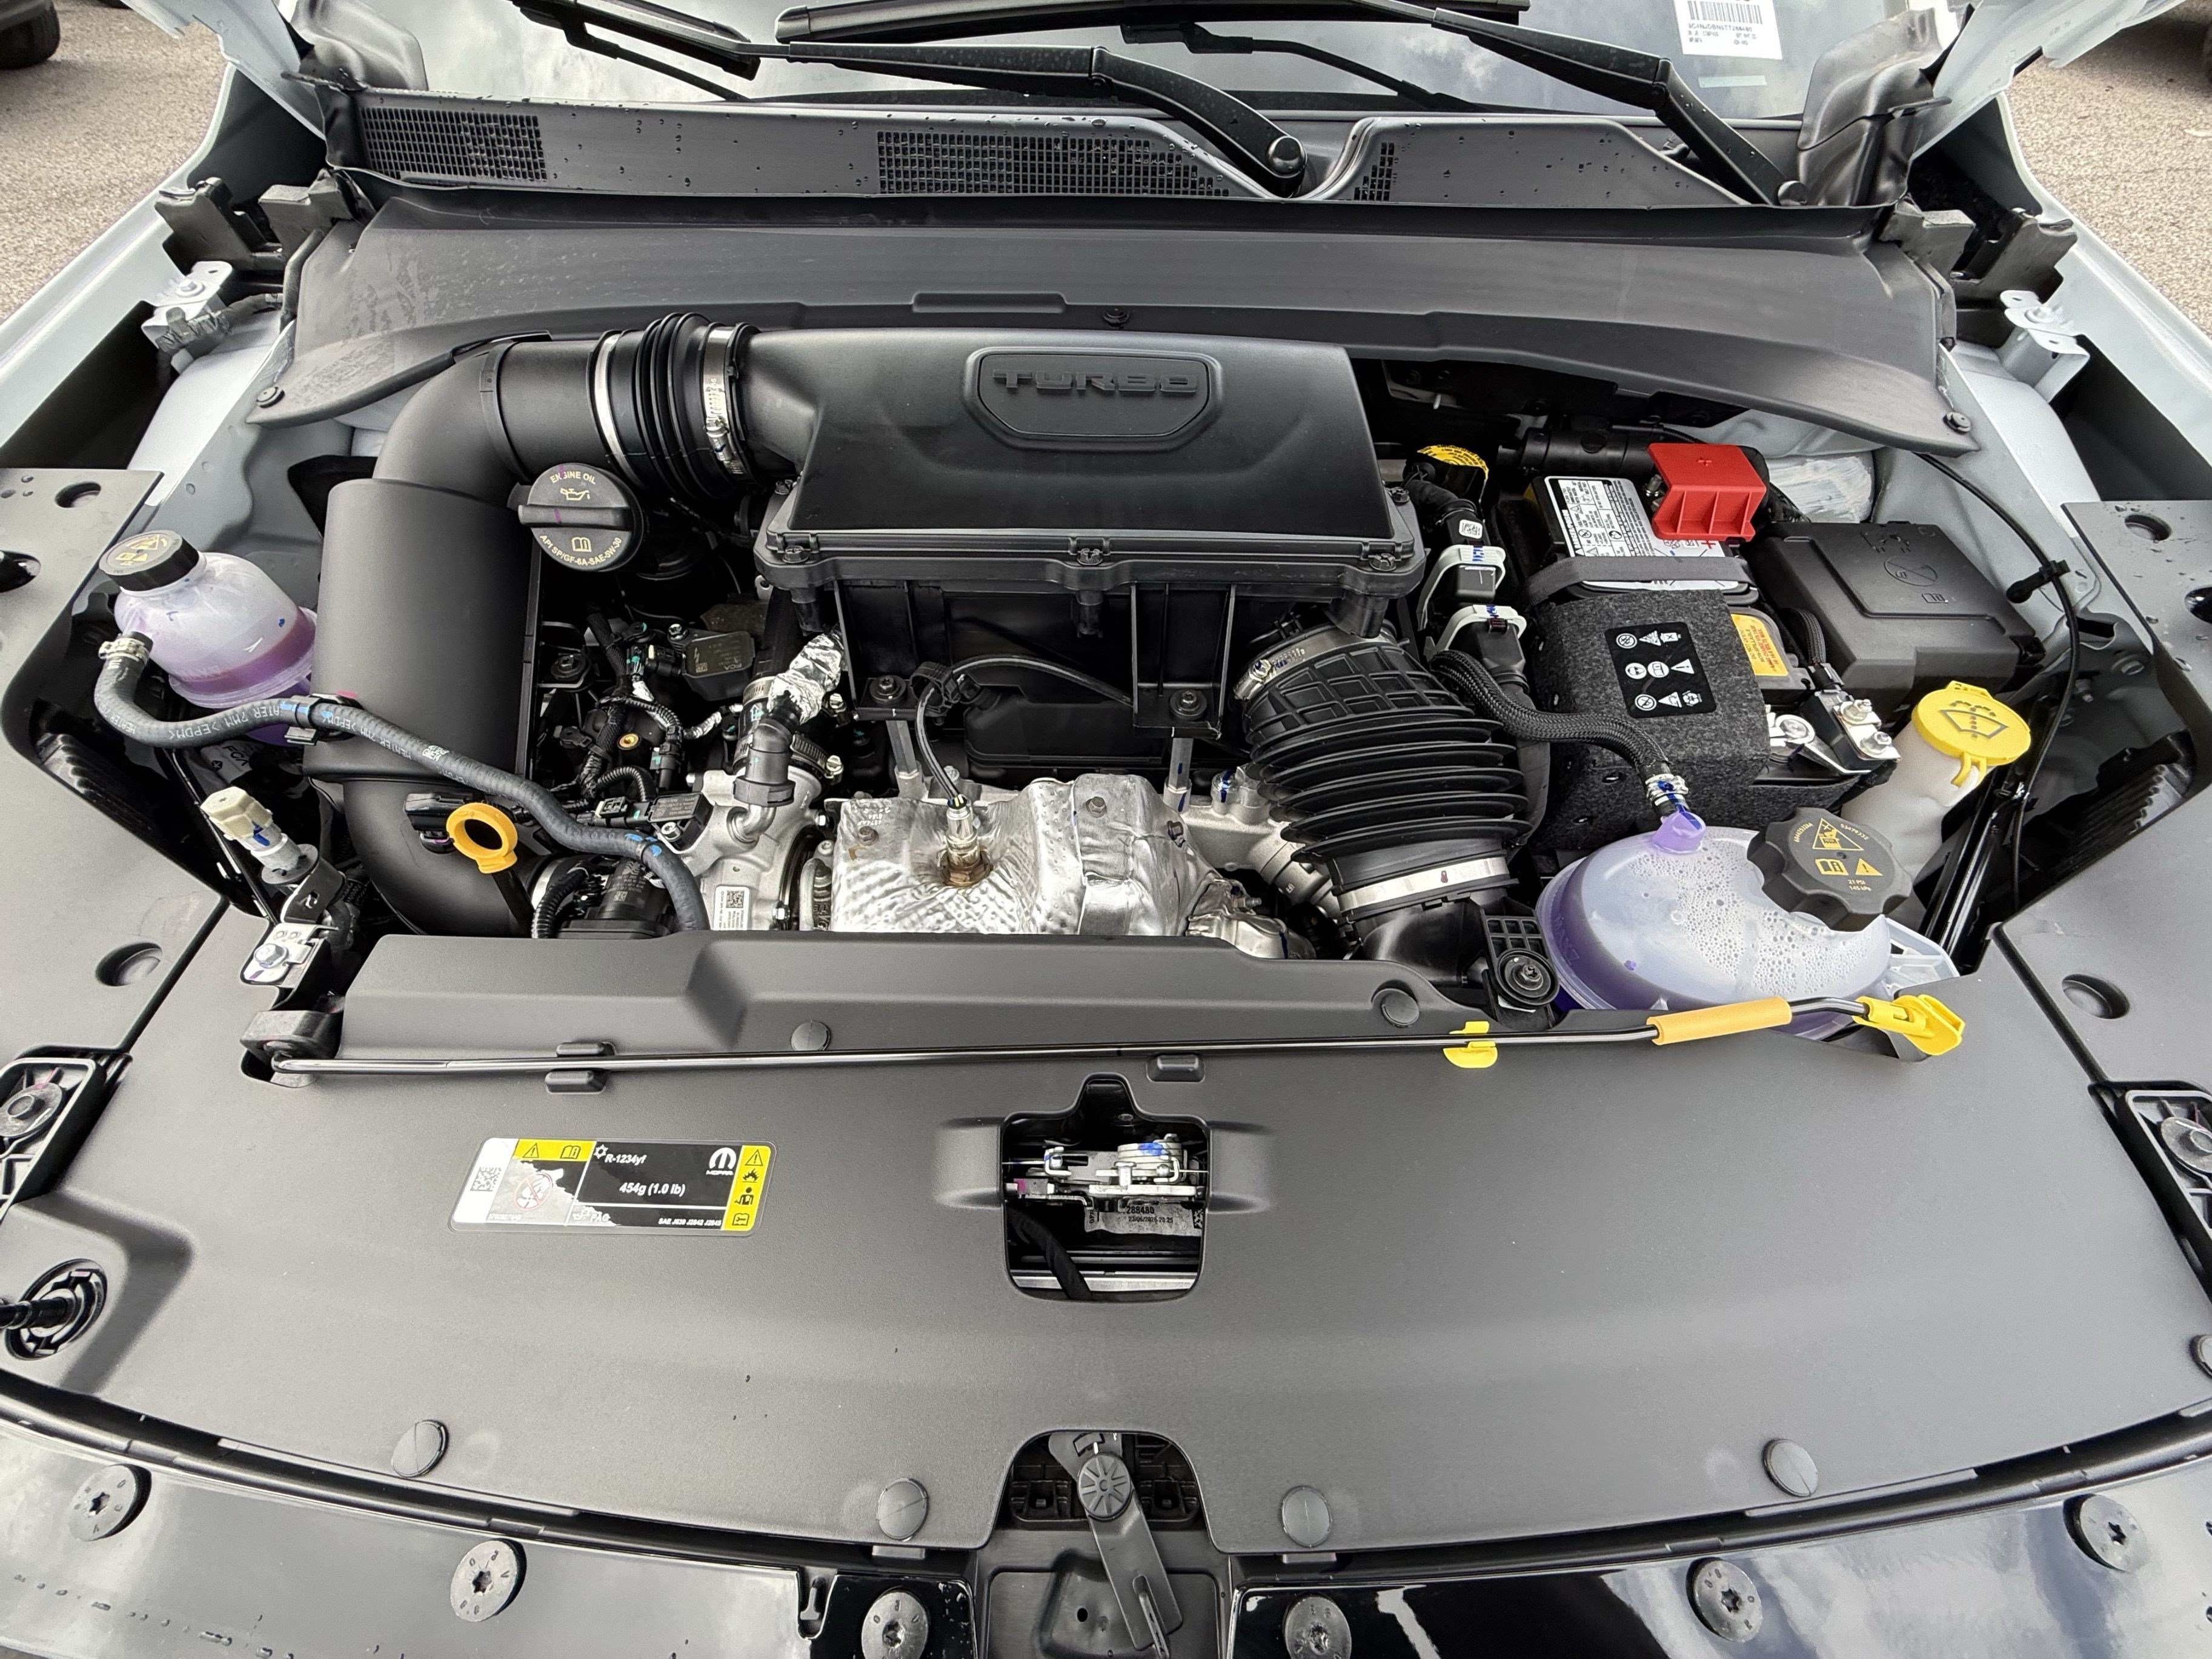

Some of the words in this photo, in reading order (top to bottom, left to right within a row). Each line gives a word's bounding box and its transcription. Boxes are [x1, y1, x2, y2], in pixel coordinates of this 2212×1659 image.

[993, 368, 1198, 393] TURBO
[583, 473, 596, 485] OIL
[539, 534, 554, 547] API
[604, 1153, 648, 1166] R-1234yf
[619, 1182, 647, 1196] 454g
[647, 1183, 669, 1197] (1.0
[670, 1183, 686, 1197] lb)
[1126, 1206, 1155, 1214] 288480
[590, 1212, 611, 1222] PAG
[658, 1214, 672, 1225] SAE
